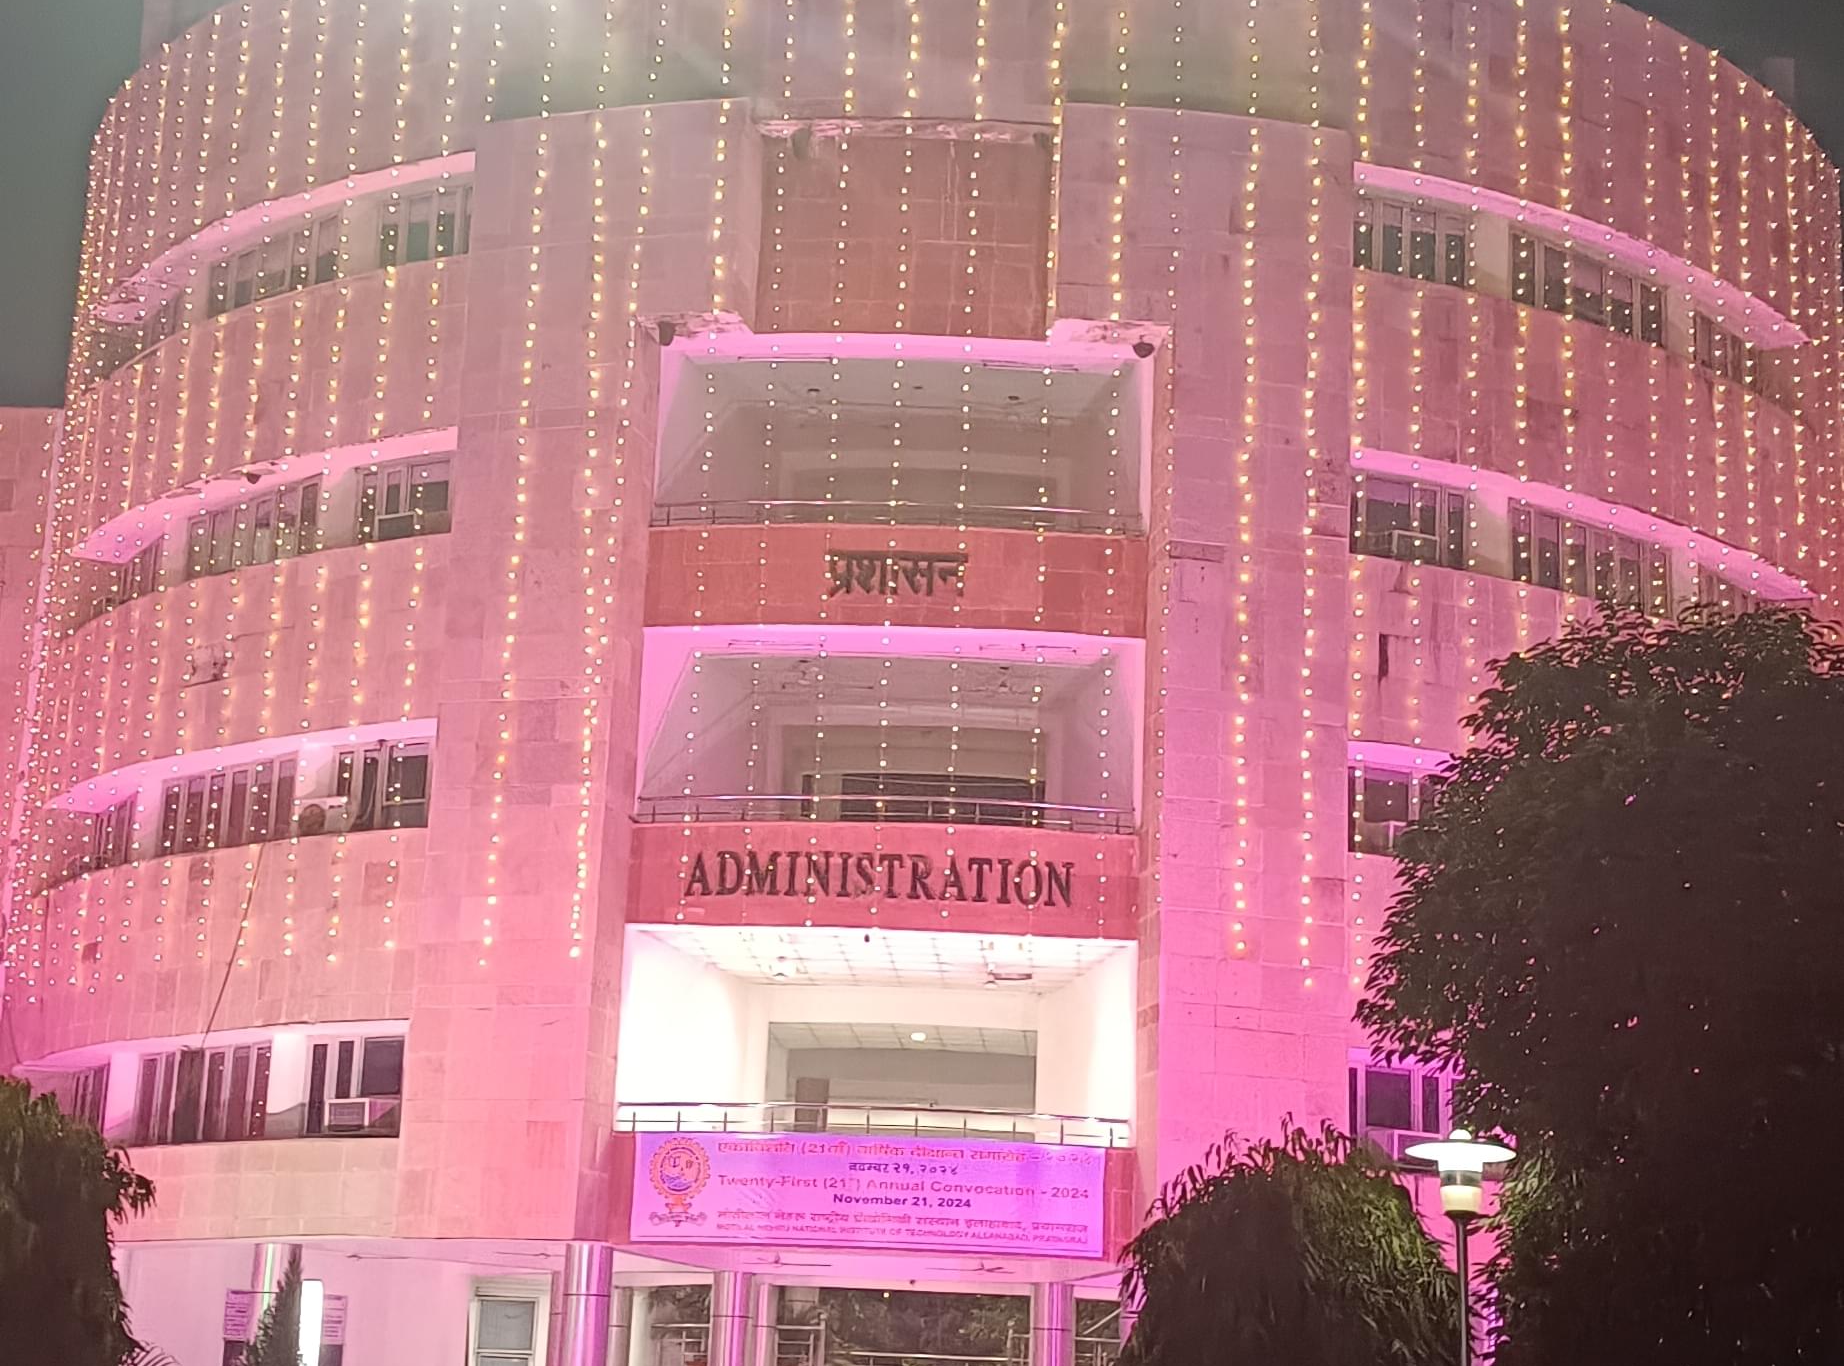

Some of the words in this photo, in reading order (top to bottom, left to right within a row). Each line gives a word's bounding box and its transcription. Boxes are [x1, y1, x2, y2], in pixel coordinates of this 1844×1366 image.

[825, 549, 969, 598] प्रशासन
[684, 849, 1075, 907] ADMINISTRATION
[718, 1175, 818, 1189] Twenty-First
[823, 1177, 860, 1191] (21)
[866, 1179, 925, 1193] Annual
[930, 1180, 1035, 1197] Convocation
[1051, 1186, 1089, 1200] 2024
[833, 1193, 908, 1206] November
[911, 1196, 933, 1208] 21,
[937, 1197, 971, 1208] 2024
